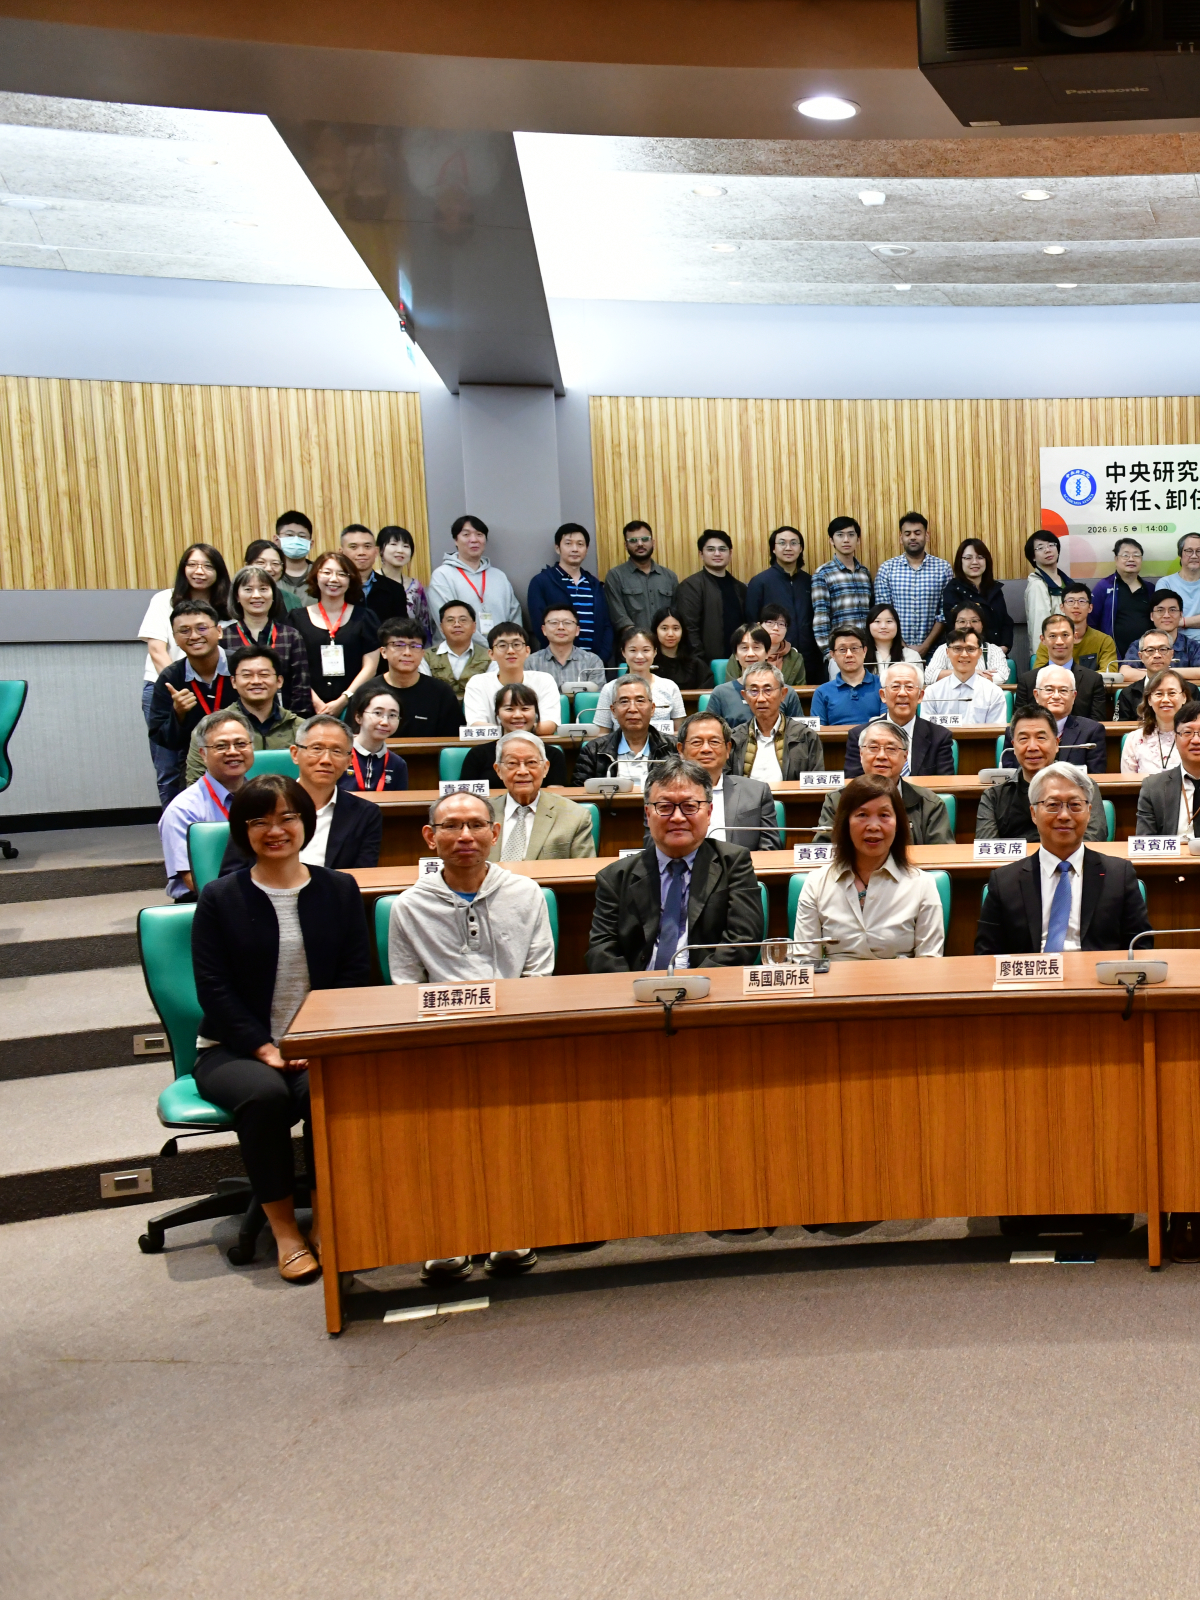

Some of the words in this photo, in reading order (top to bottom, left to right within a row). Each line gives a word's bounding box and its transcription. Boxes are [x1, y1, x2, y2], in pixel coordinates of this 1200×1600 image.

[1065, 86, 1150, 95] Panasonic
[1145, 524, 1168, 532] 14:00
[929, 715, 960, 725] 貴賓席
[463, 727, 499, 738] 貴賓席
[803, 774, 841, 785] 貴賓席
[443, 783, 486, 794] 貴賓席
[978, 842, 1023, 855] 貴賓席
[1133, 838, 1177, 851] 貴賓席
[1000, 958, 1060, 977] 廖俊智院長
[748, 968, 810, 988] 馬國鳳所長
[422, 987, 492, 1009] 鍾孫霖所長
